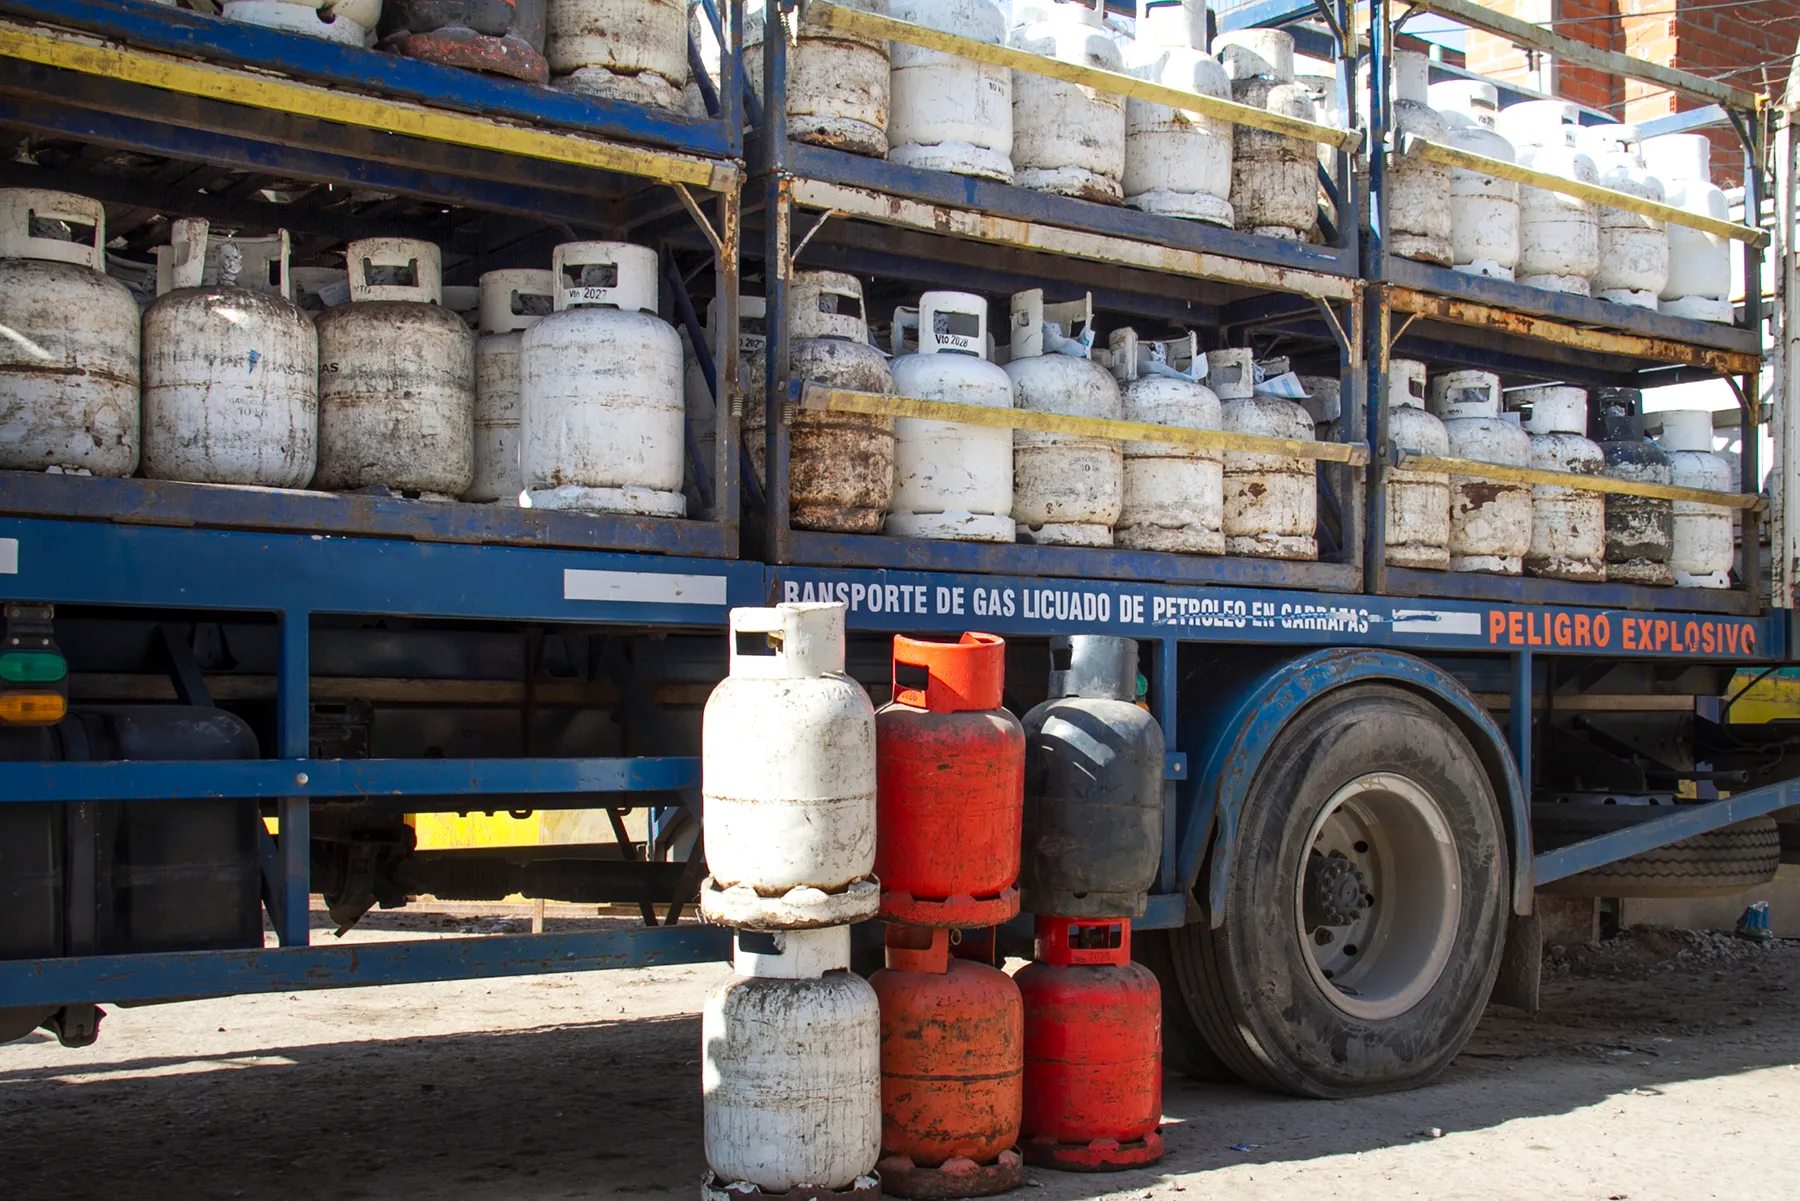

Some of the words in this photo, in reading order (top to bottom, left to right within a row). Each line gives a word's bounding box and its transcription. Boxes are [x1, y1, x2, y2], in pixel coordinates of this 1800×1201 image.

[935, 334, 949, 344] Vto
[950, 335, 969, 348] 2028
[936, 586, 965, 616] DE
[973, 587, 1016, 617] GAS
[1023, 588, 1111, 622] LICUADO
[1119, 594, 1145, 623] DE
[1152, 596, 1246, 628] PETROLEO
[1252, 602, 1276, 627] EN
[1489, 610, 1611, 648] PELIGRO
[1621, 617, 1756, 655] EXPLOSIVO
